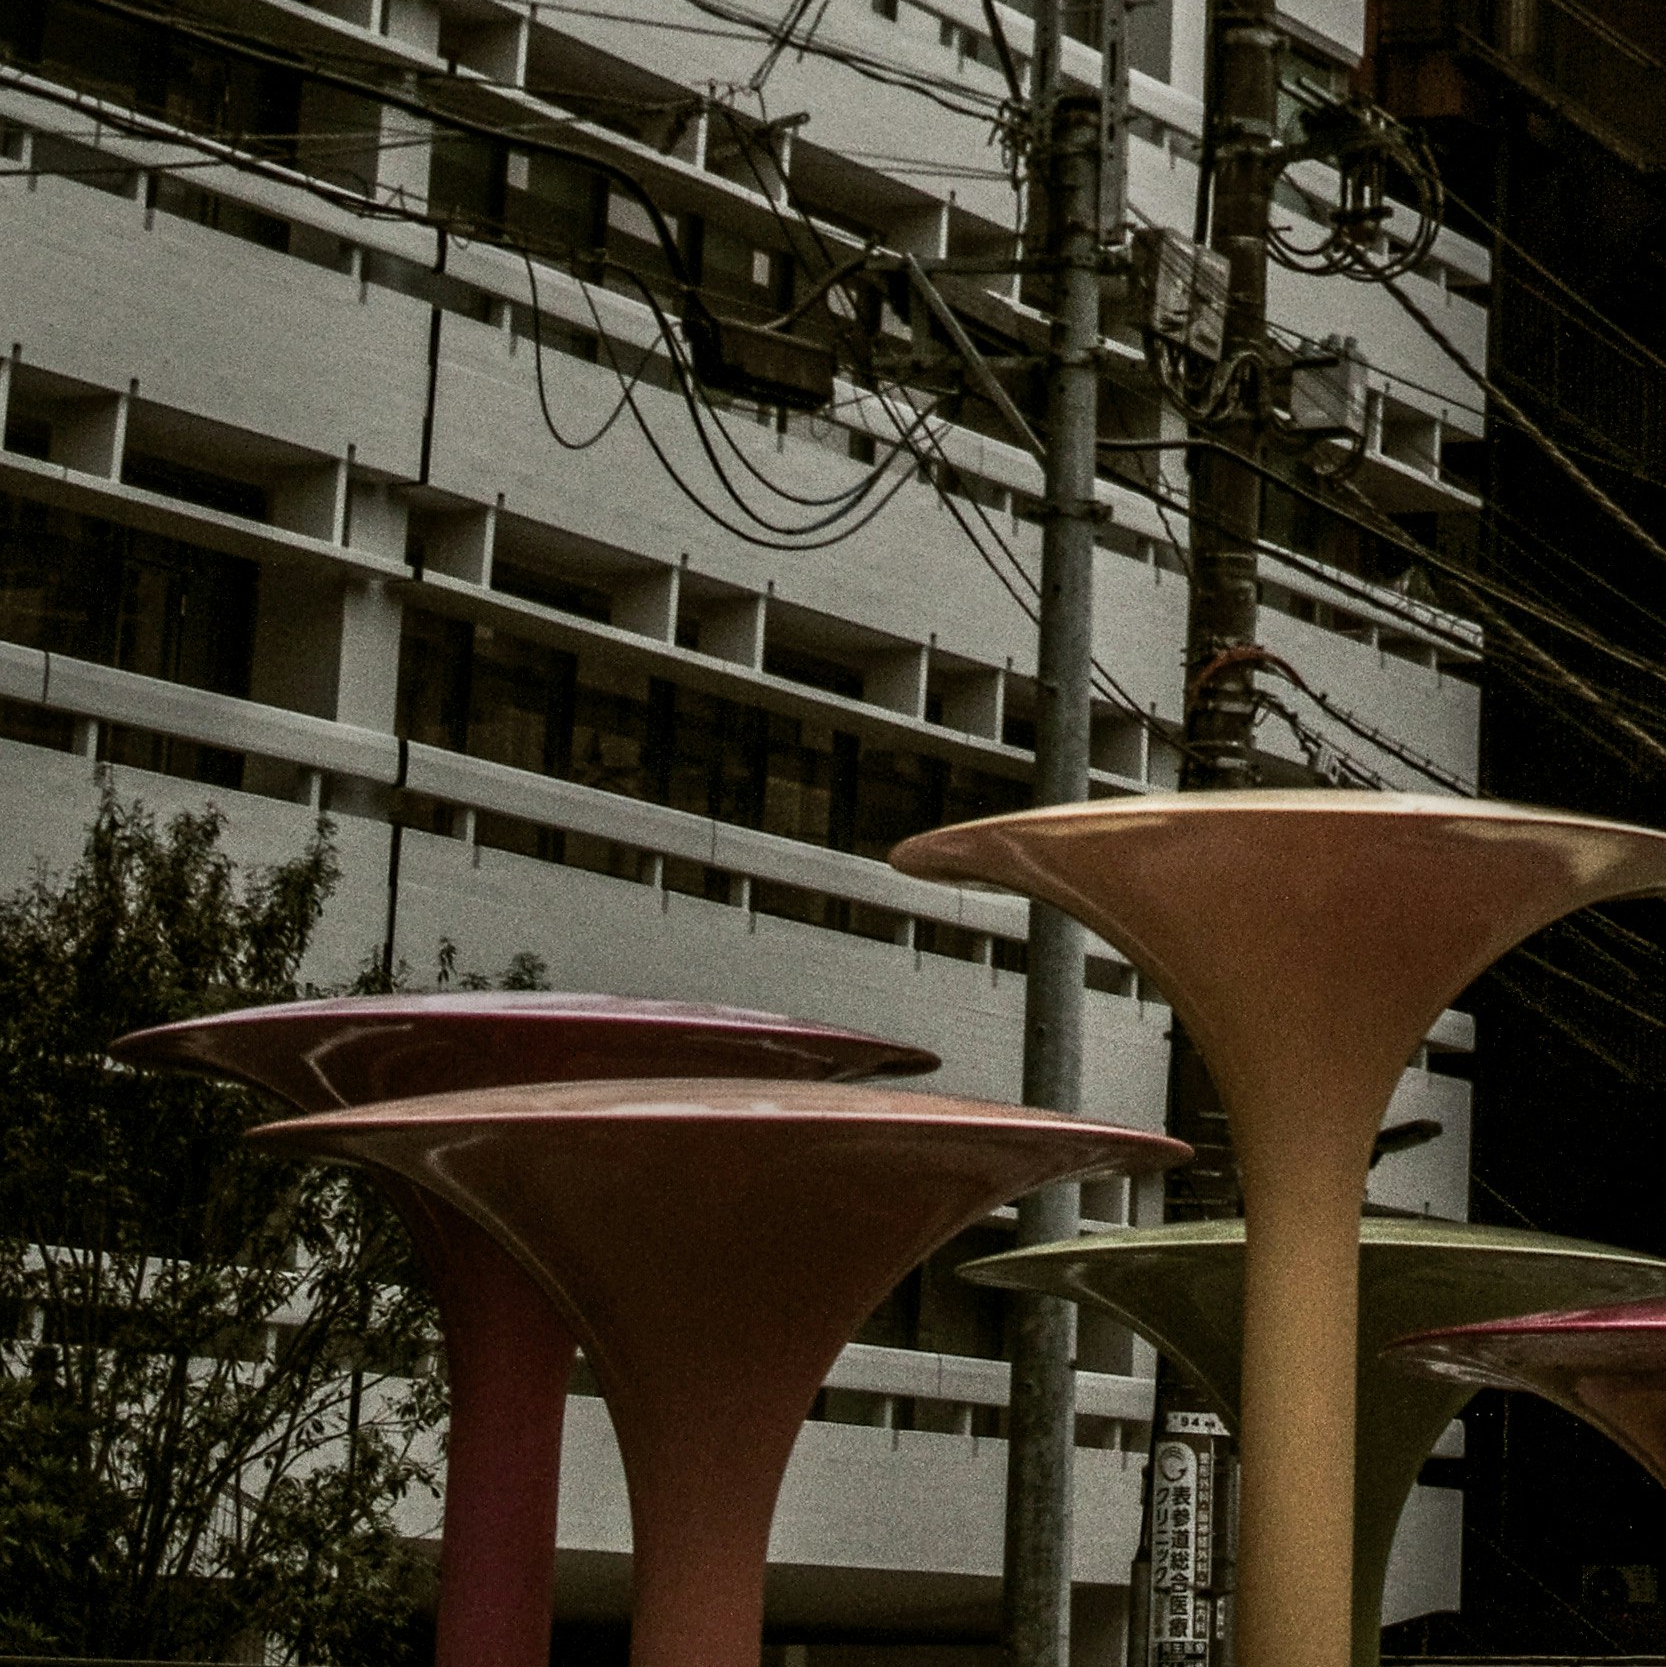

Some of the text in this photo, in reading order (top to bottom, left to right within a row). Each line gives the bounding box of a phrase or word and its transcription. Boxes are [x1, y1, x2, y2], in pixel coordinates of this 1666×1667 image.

[1155, 1487, 1170, 1585] クリニック
[1168, 1487, 1191, 1638] 表参道総合医療
